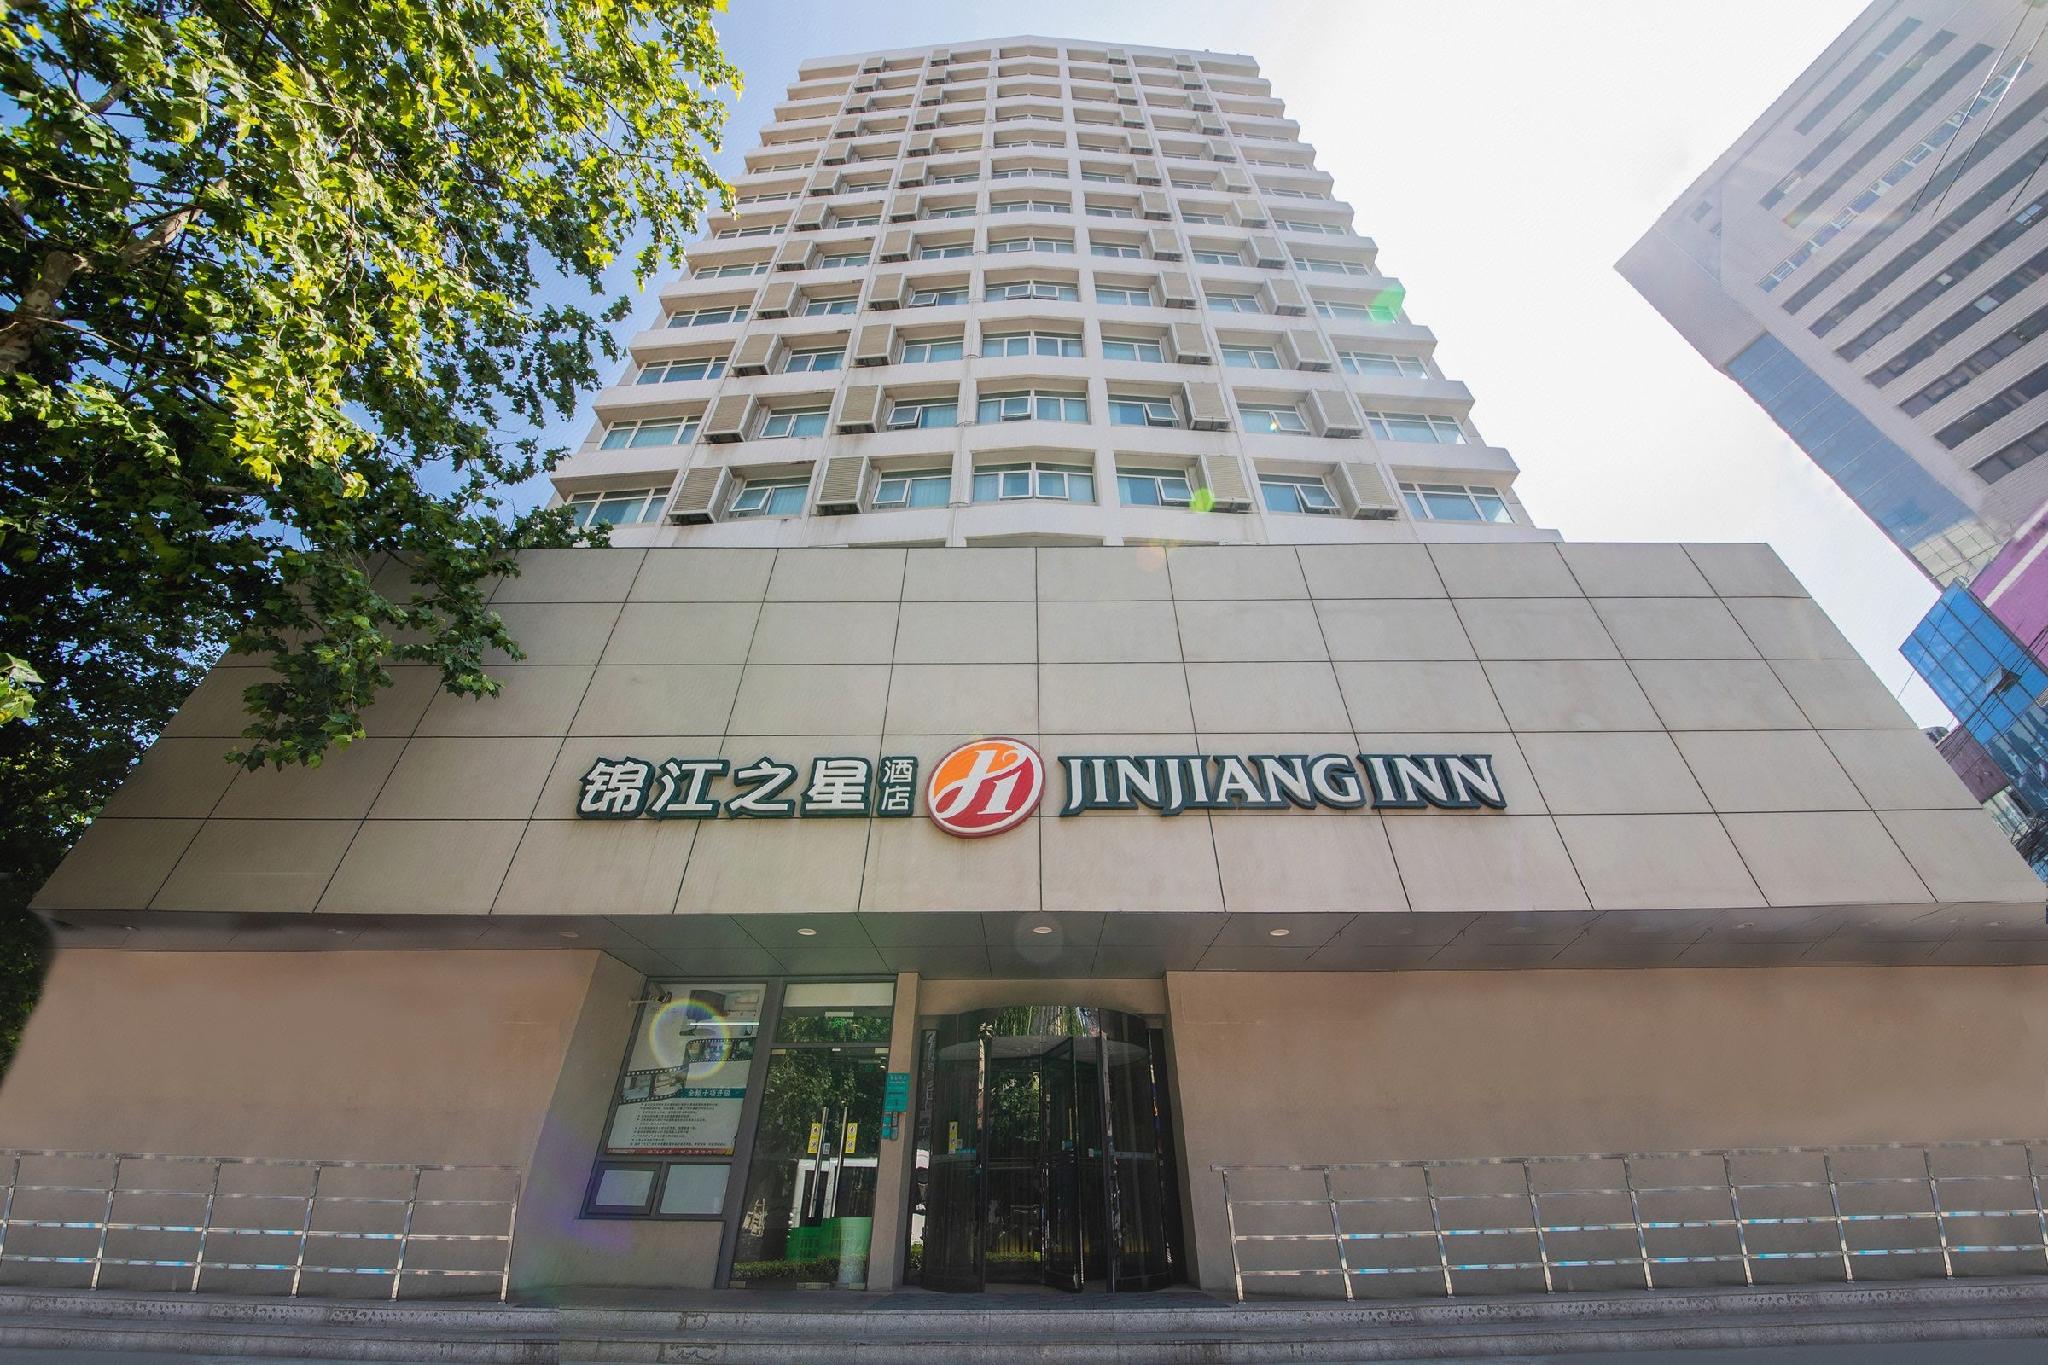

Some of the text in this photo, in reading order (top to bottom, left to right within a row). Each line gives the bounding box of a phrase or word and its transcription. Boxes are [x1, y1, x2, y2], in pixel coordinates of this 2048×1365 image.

[578, 758, 870, 817] 锦江之星
[881, 758, 915, 813] 酒店
[1060, 756, 1504, 814] JINJIANG INN
